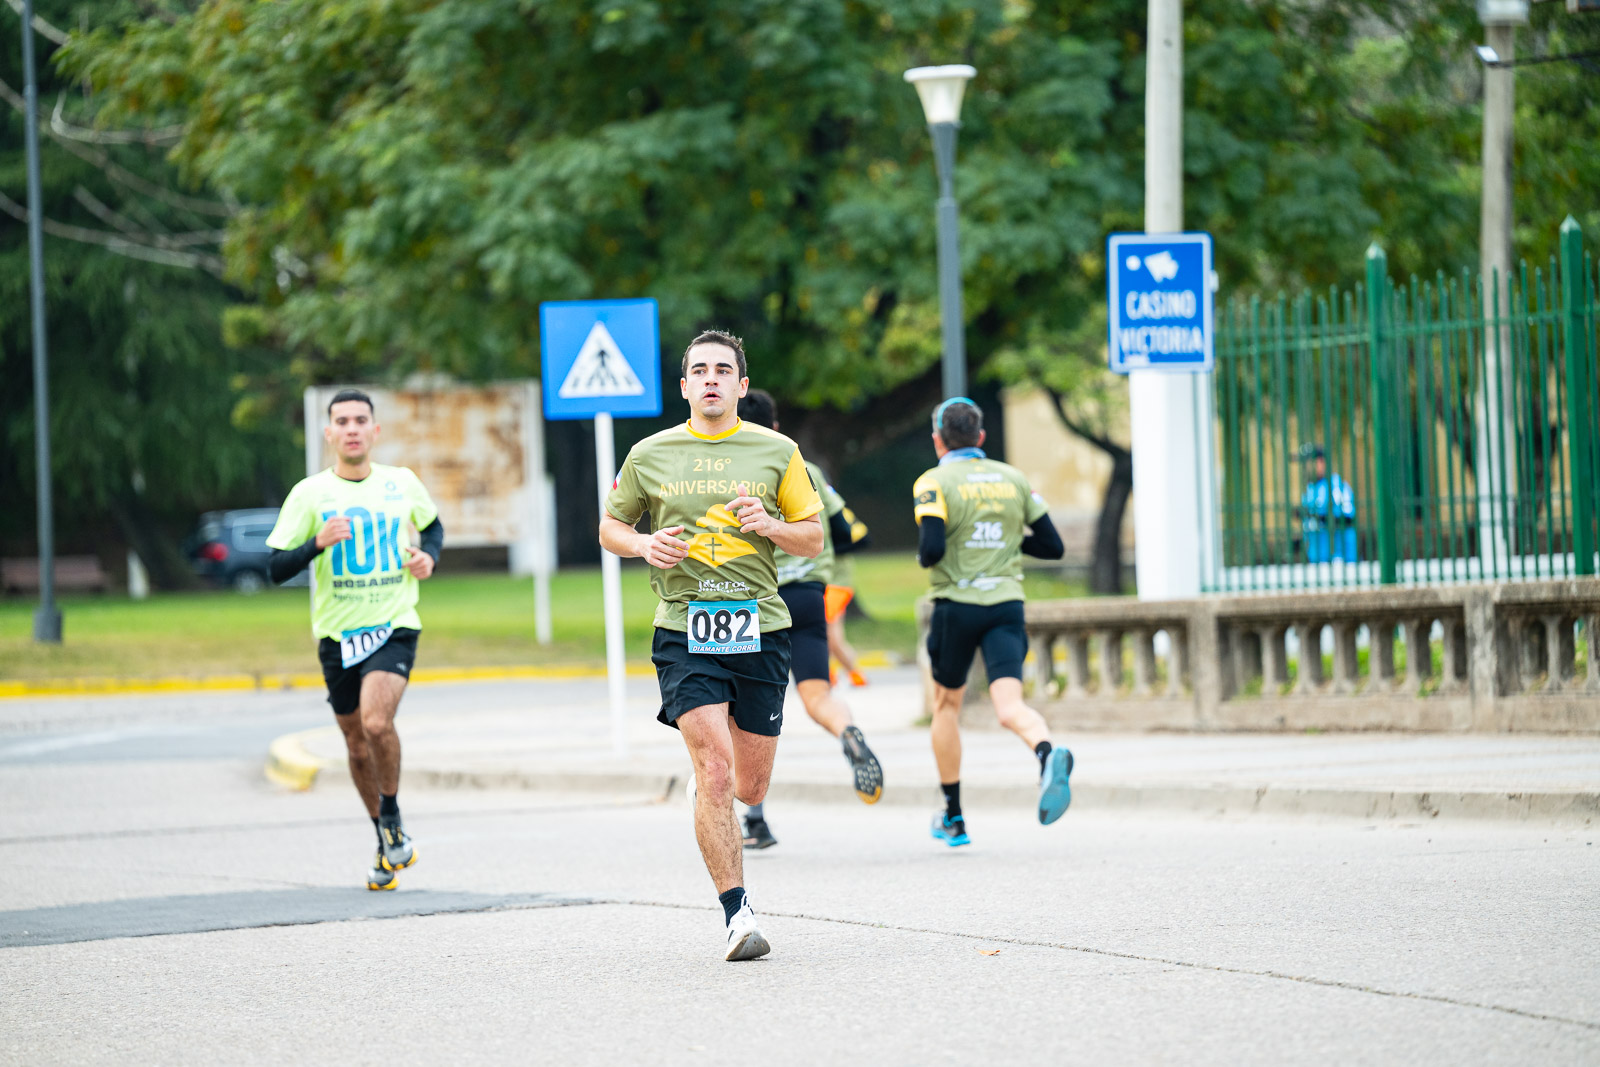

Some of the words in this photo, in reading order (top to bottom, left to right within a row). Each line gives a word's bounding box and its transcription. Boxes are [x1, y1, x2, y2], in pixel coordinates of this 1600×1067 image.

[1125, 290, 1197, 320] CASINO
[1119, 326, 1204, 354] VICTORIA
[693, 458, 732, 472] 216°
[658, 480, 767, 498] ANIVERSARIO
[321, 506, 403, 576] 10K
[971, 521, 1003, 541] 216
[333, 574, 403, 588] ROSARIO
[691, 609, 754, 645] 082
[692, 645, 730, 653] DIAMANTE
[731, 643, 757, 652] CORRE
